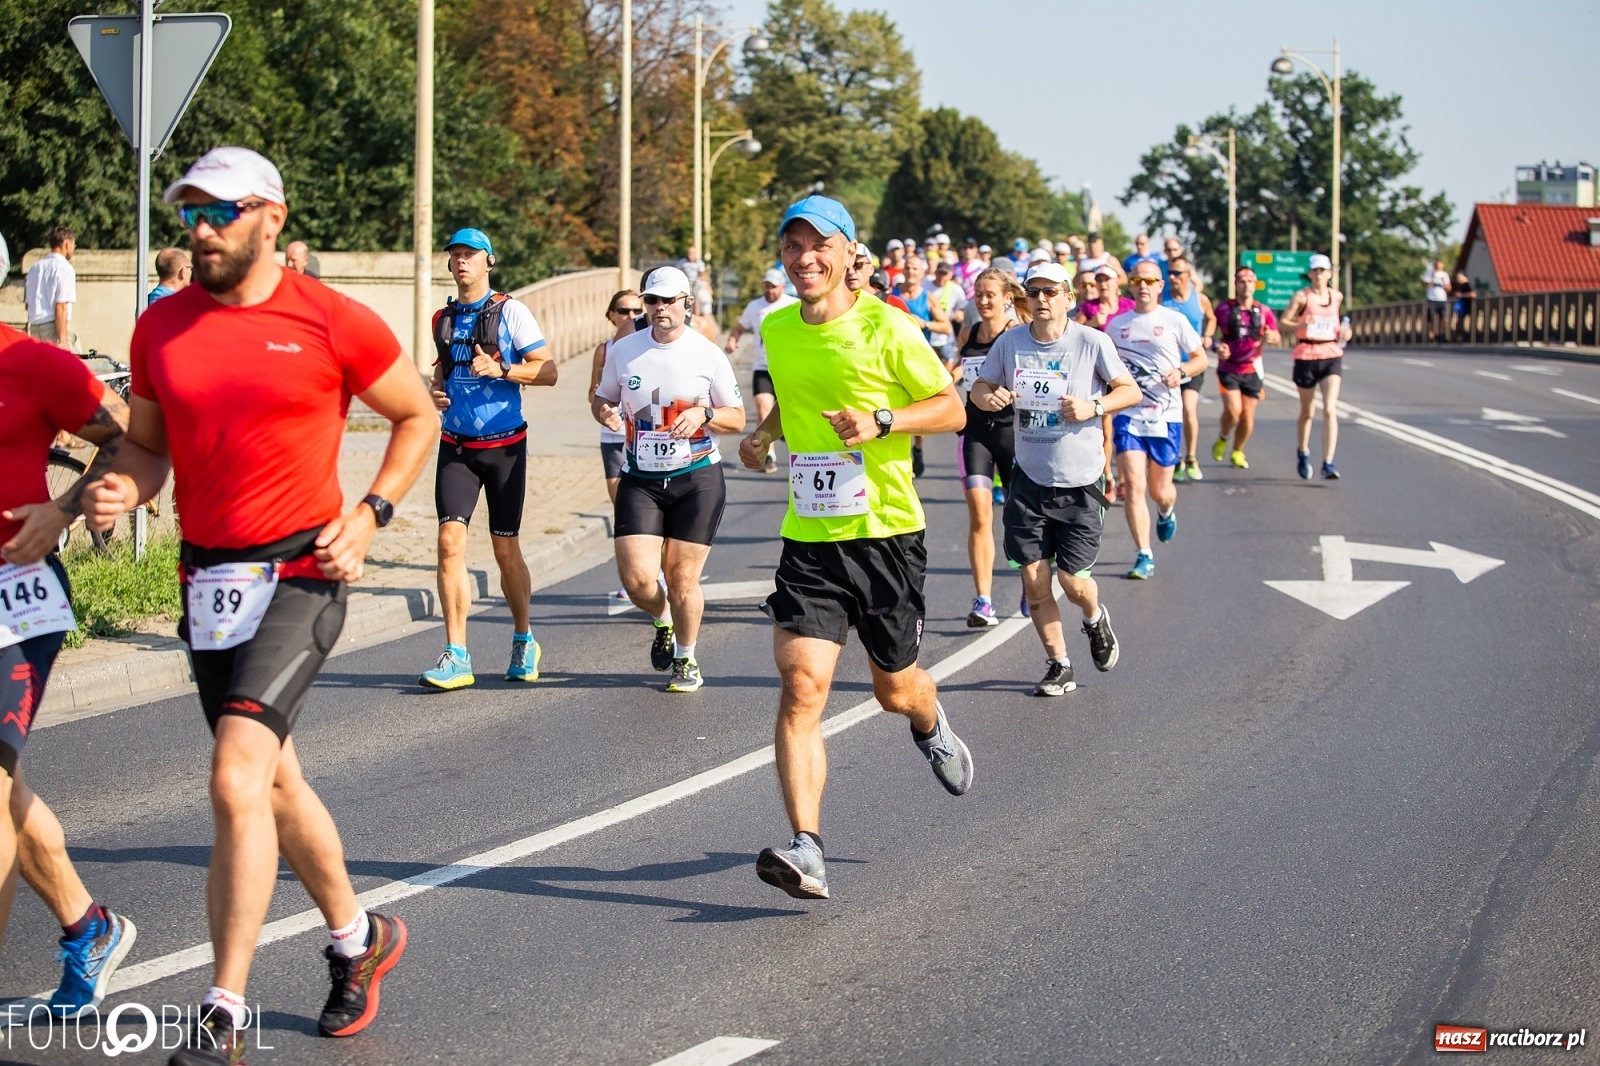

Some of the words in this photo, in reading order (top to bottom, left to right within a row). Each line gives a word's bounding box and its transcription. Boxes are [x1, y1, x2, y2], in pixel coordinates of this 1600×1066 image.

[1033, 381, 1050, 394] 96
[653, 442, 677, 456] 195
[813, 470, 836, 491] 67
[0, 577, 48, 611] 146
[213, 588, 242, 614] 89
